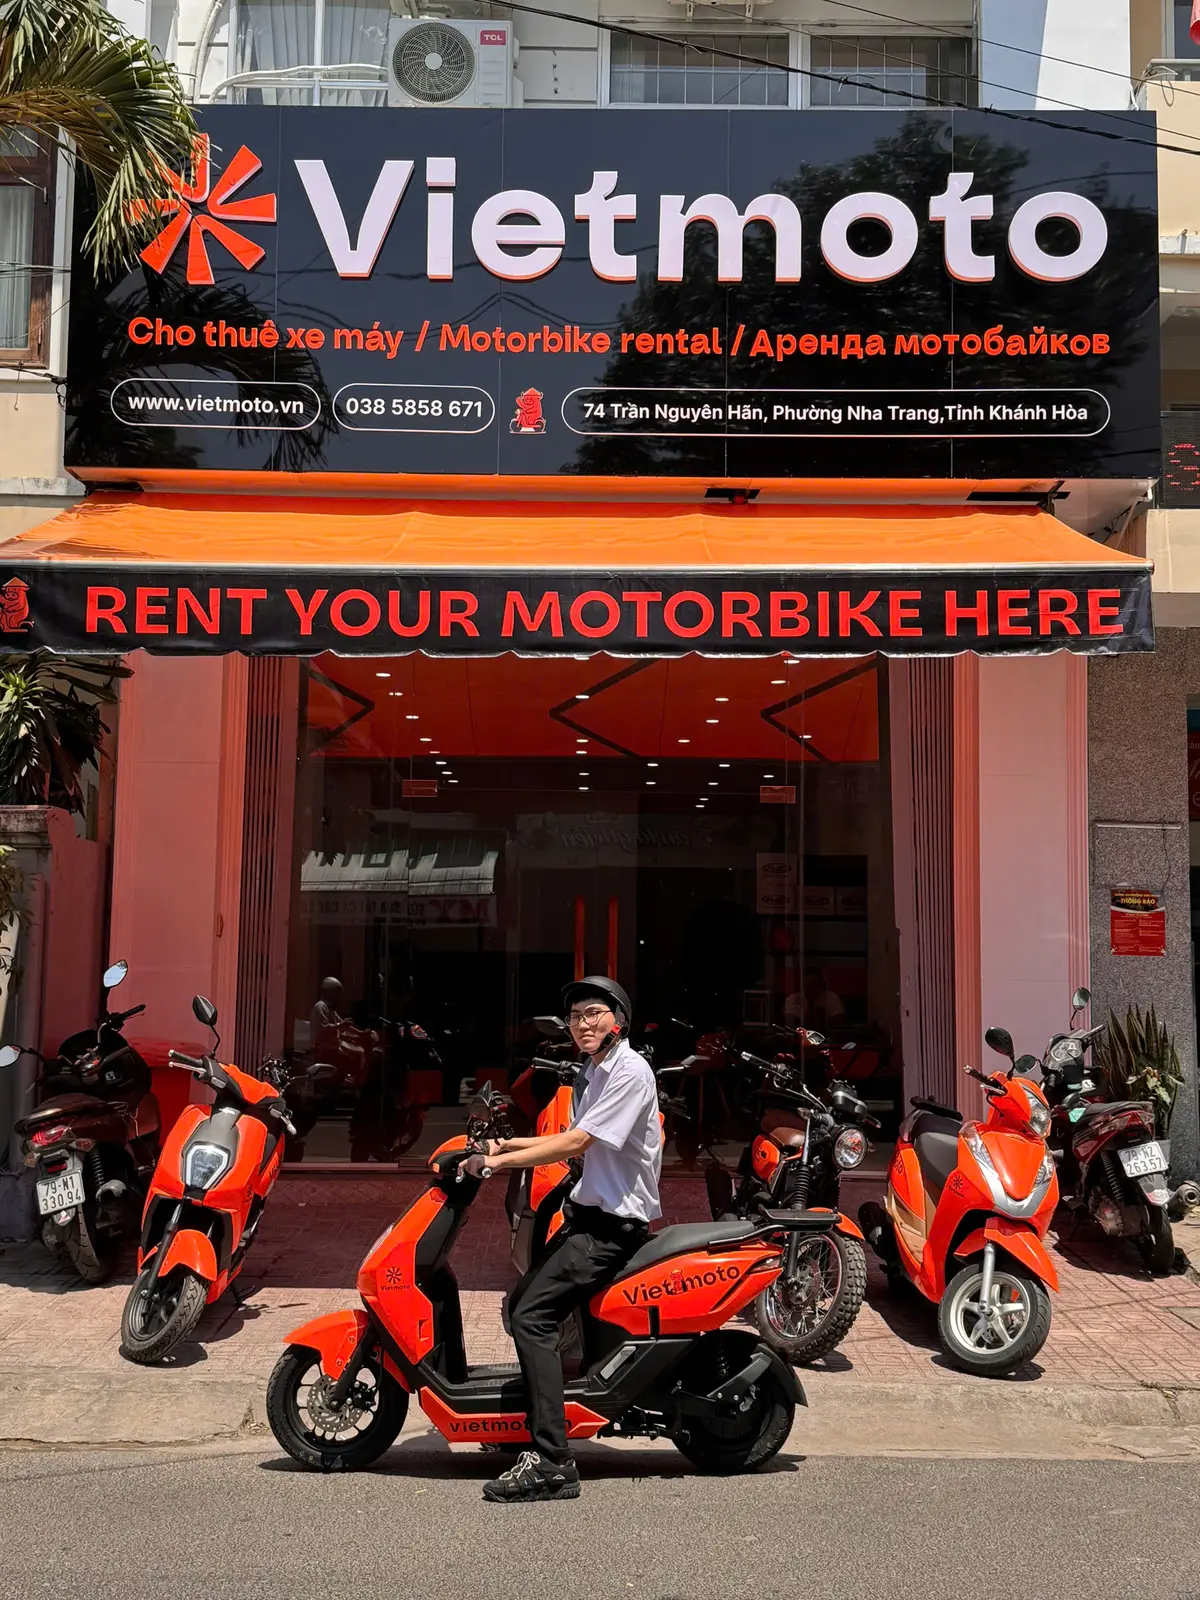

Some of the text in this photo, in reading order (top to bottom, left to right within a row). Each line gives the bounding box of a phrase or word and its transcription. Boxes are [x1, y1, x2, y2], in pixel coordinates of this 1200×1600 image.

[294, 156, 1109, 285] Vietmoto
[128, 316, 196, 346] Cho
[203, 319, 279, 348] thuê
[286, 327, 325, 349] xe
[333, 321, 404, 360] máy
[439, 324, 611, 353] Motorbike
[621, 326, 722, 355] rental
[749, 324, 1111, 362] Аренда мотобайков
[128, 394, 304, 415] www.vietmoto.vn
[346, 397, 483, 418] 038 5858 671
[583, 403, 606, 419] 74
[610, 402, 650, 420] Trần
[654, 403, 723, 424] Nguyên
[727, 403, 768, 423] Hãn,
[773, 404, 843, 424] Phường
[847, 405, 883, 421] Nha
[989, 404, 1047, 421] Khánh
[1052, 403, 1088, 421] Hòa
[85, 585, 1125, 640] RENT YOUR MOTORBIKE HERE
[1126, 1157, 1163, 1175] 263.57
[44, 1176, 75, 1196] 79-N1
[42, 1189, 81, 1211] 330.94
